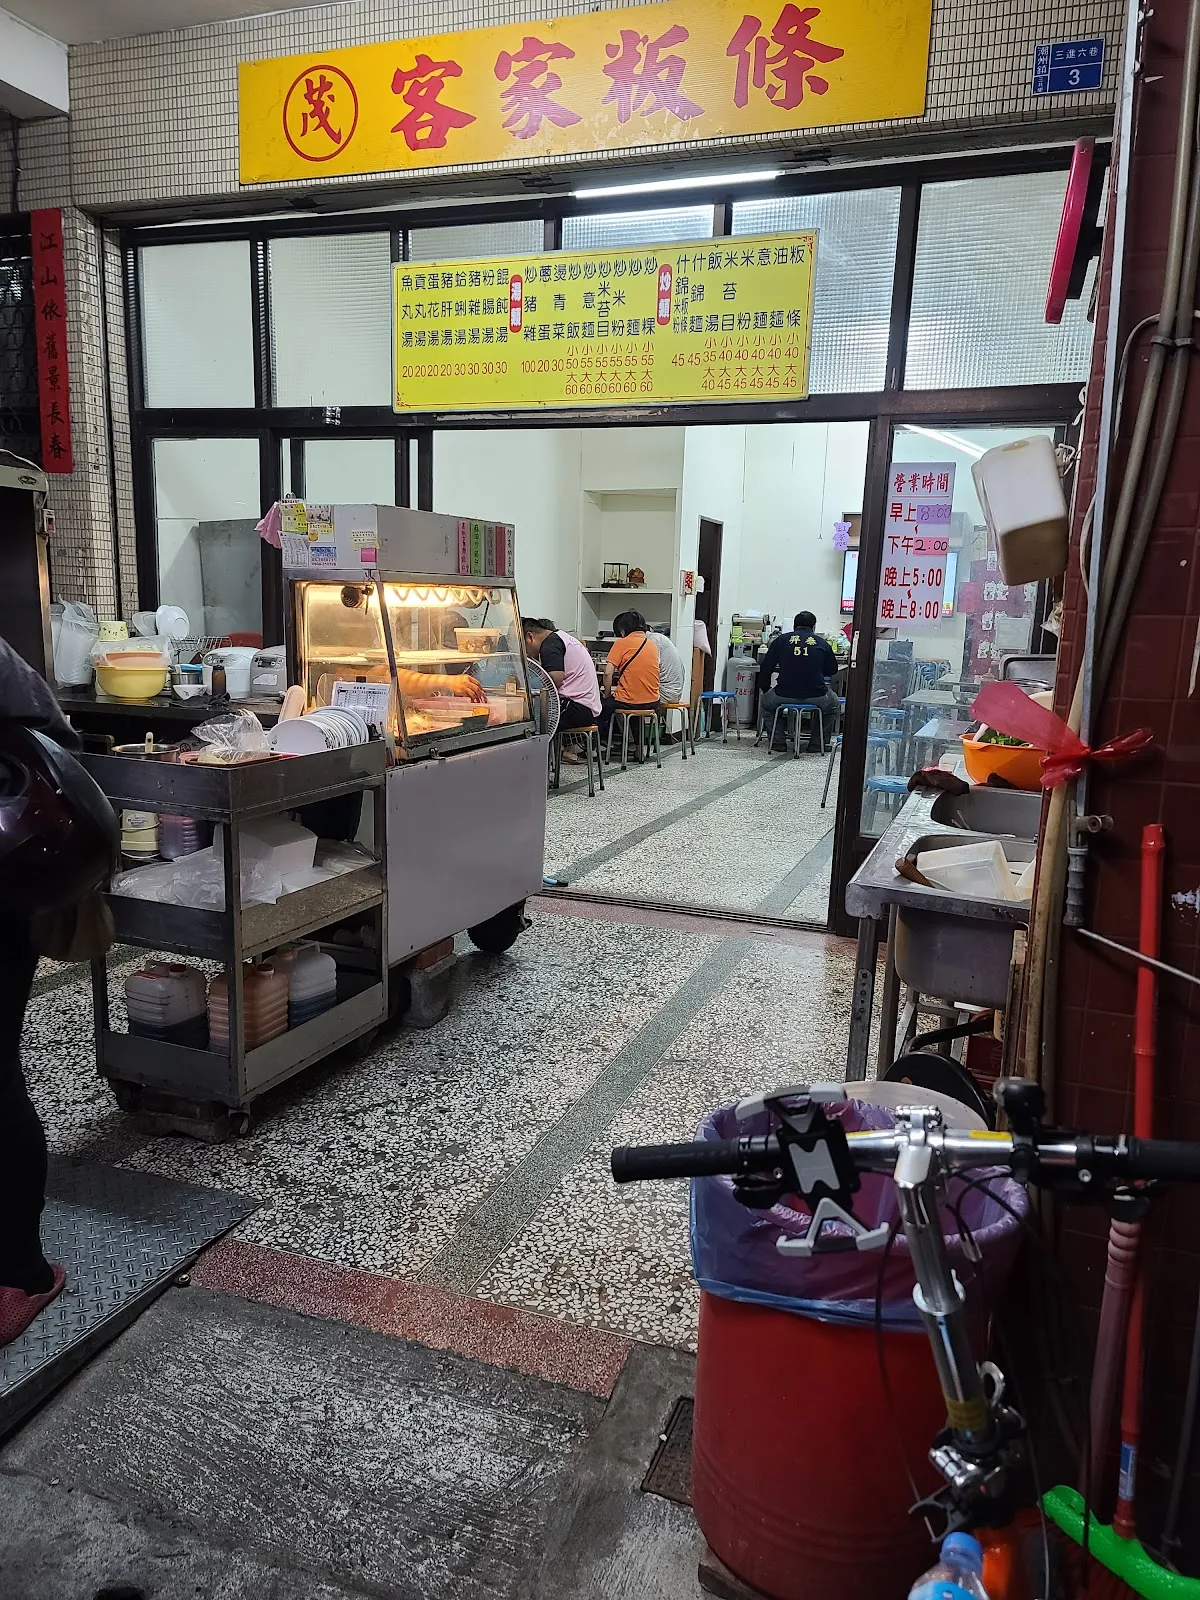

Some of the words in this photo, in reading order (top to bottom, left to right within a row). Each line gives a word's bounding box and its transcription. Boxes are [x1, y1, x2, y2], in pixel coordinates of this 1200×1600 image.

[1036, 46, 1049, 75] 潮州鎮
[1068, 69, 1080, 86] 3
[300, 75, 342, 144] 茂
[40, 233, 67, 460] 江山依舊景長春
[538, 360, 549, 372] 20
[552, 359, 564, 371] 30
[671, 353, 685, 366] 45
[687, 352, 701, 366] 45
[521, 360, 535, 373] 100
[893, 472, 949, 493] 營業時間
[793, 646, 809, 656] 51
